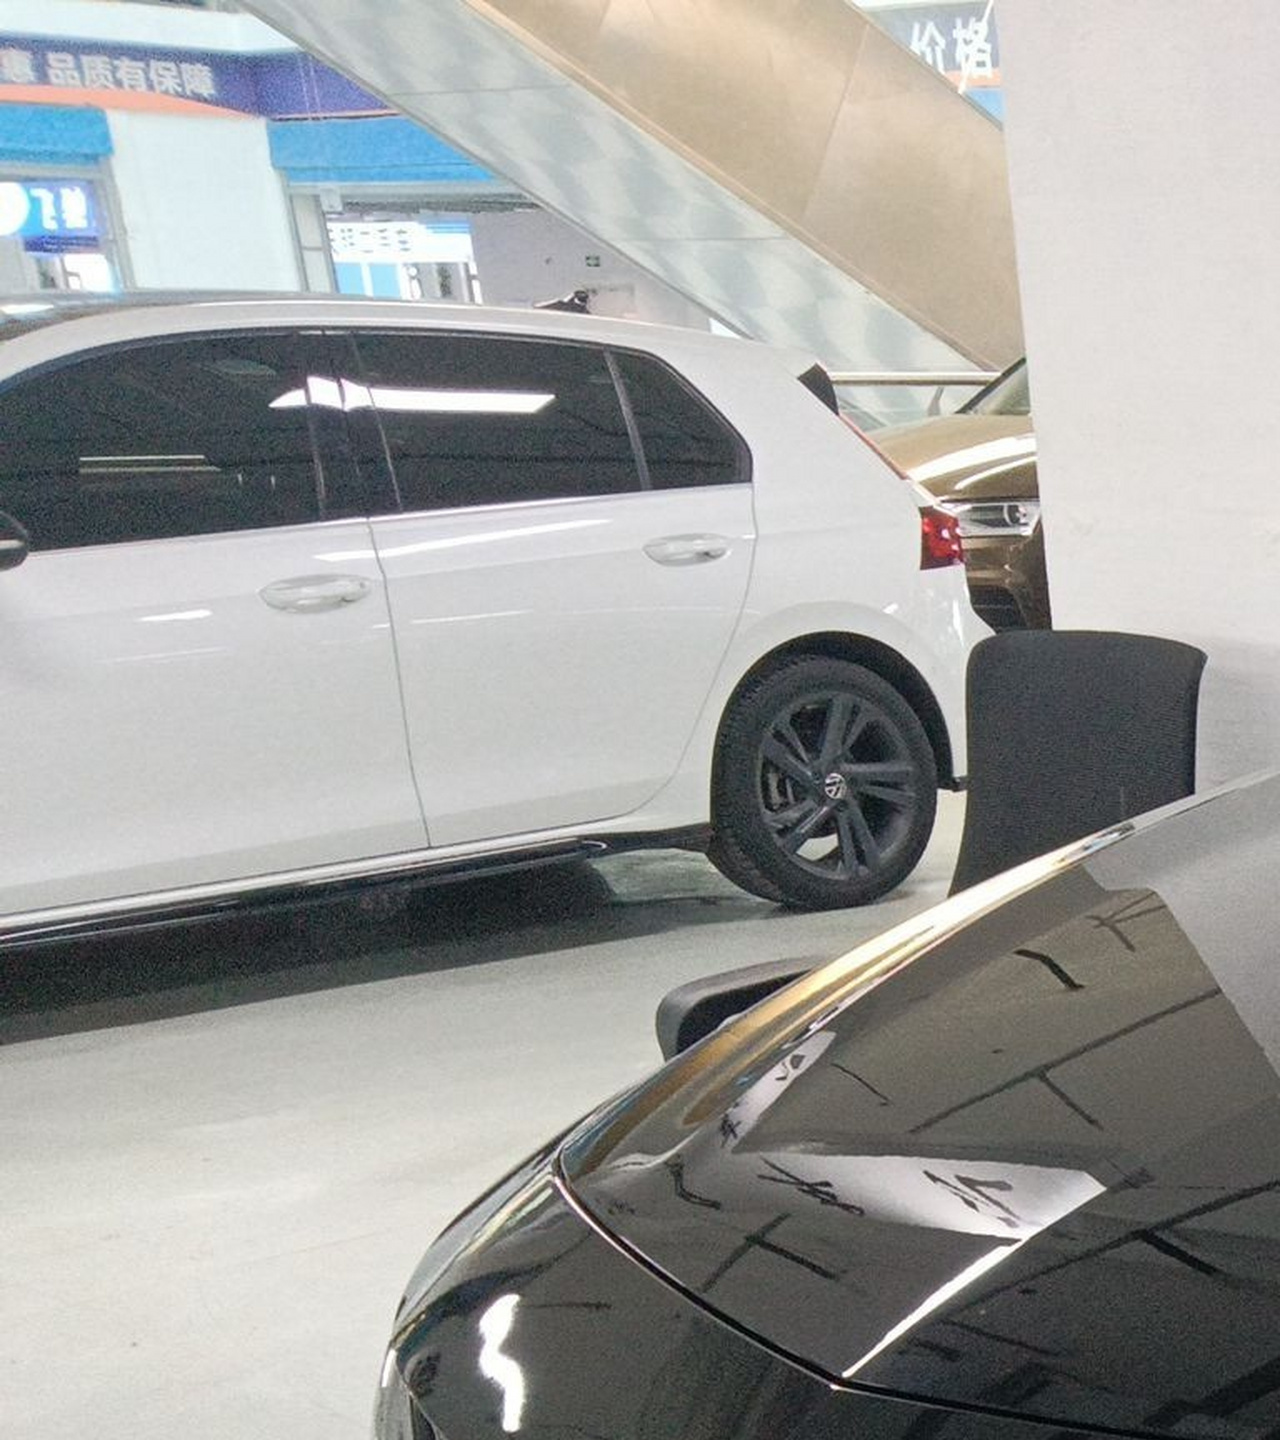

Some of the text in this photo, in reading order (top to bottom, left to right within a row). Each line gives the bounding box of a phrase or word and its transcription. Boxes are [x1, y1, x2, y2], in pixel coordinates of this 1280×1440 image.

[46, 51, 216, 98] 品质有保障
